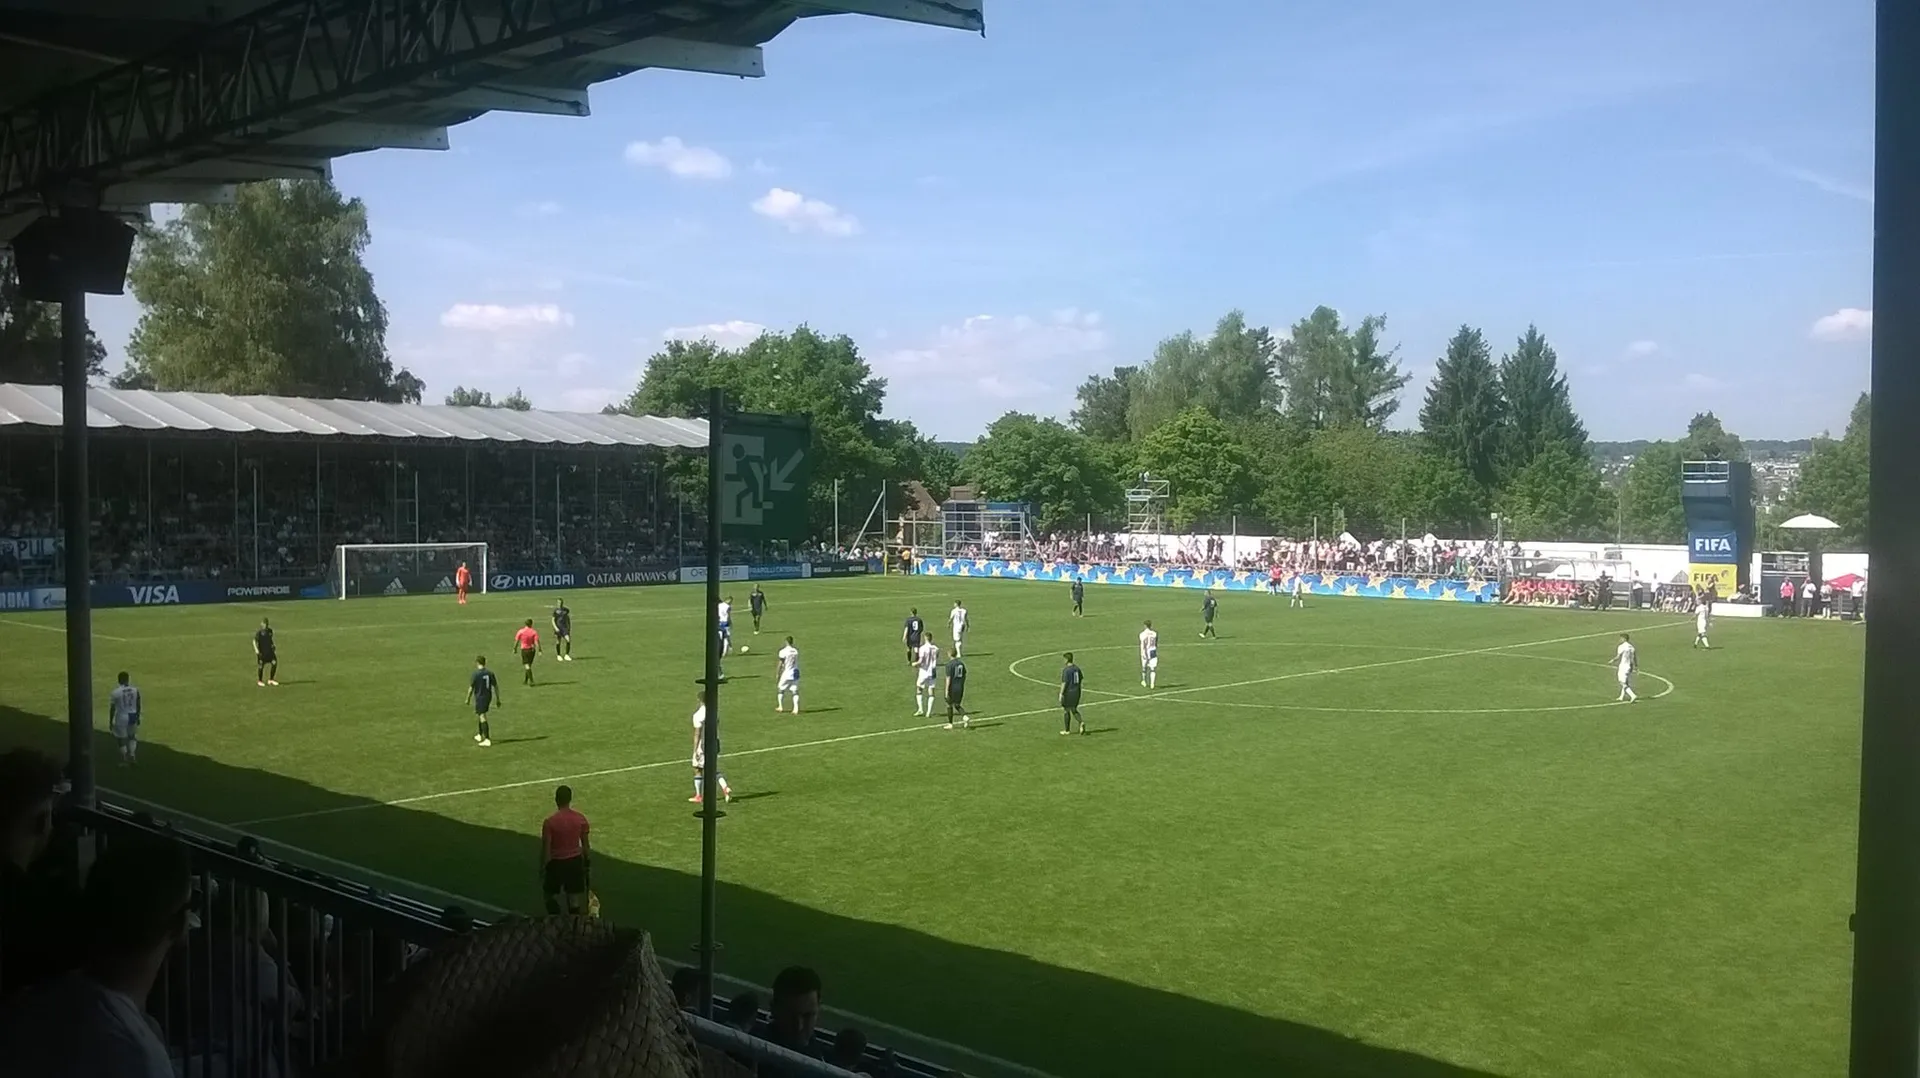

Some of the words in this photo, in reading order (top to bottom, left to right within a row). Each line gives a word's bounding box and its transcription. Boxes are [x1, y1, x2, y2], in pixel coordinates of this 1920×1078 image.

[1695, 538, 1731, 551] FIFA
[517, 574, 574, 587] HYUNDAI
[586, 572, 622, 586] QATAR
[623, 570, 667, 583] AIRWAYS
[126, 585, 180, 604] VISA
[228, 585, 290, 596] POWERADE
[912, 620, 919, 631] 9
